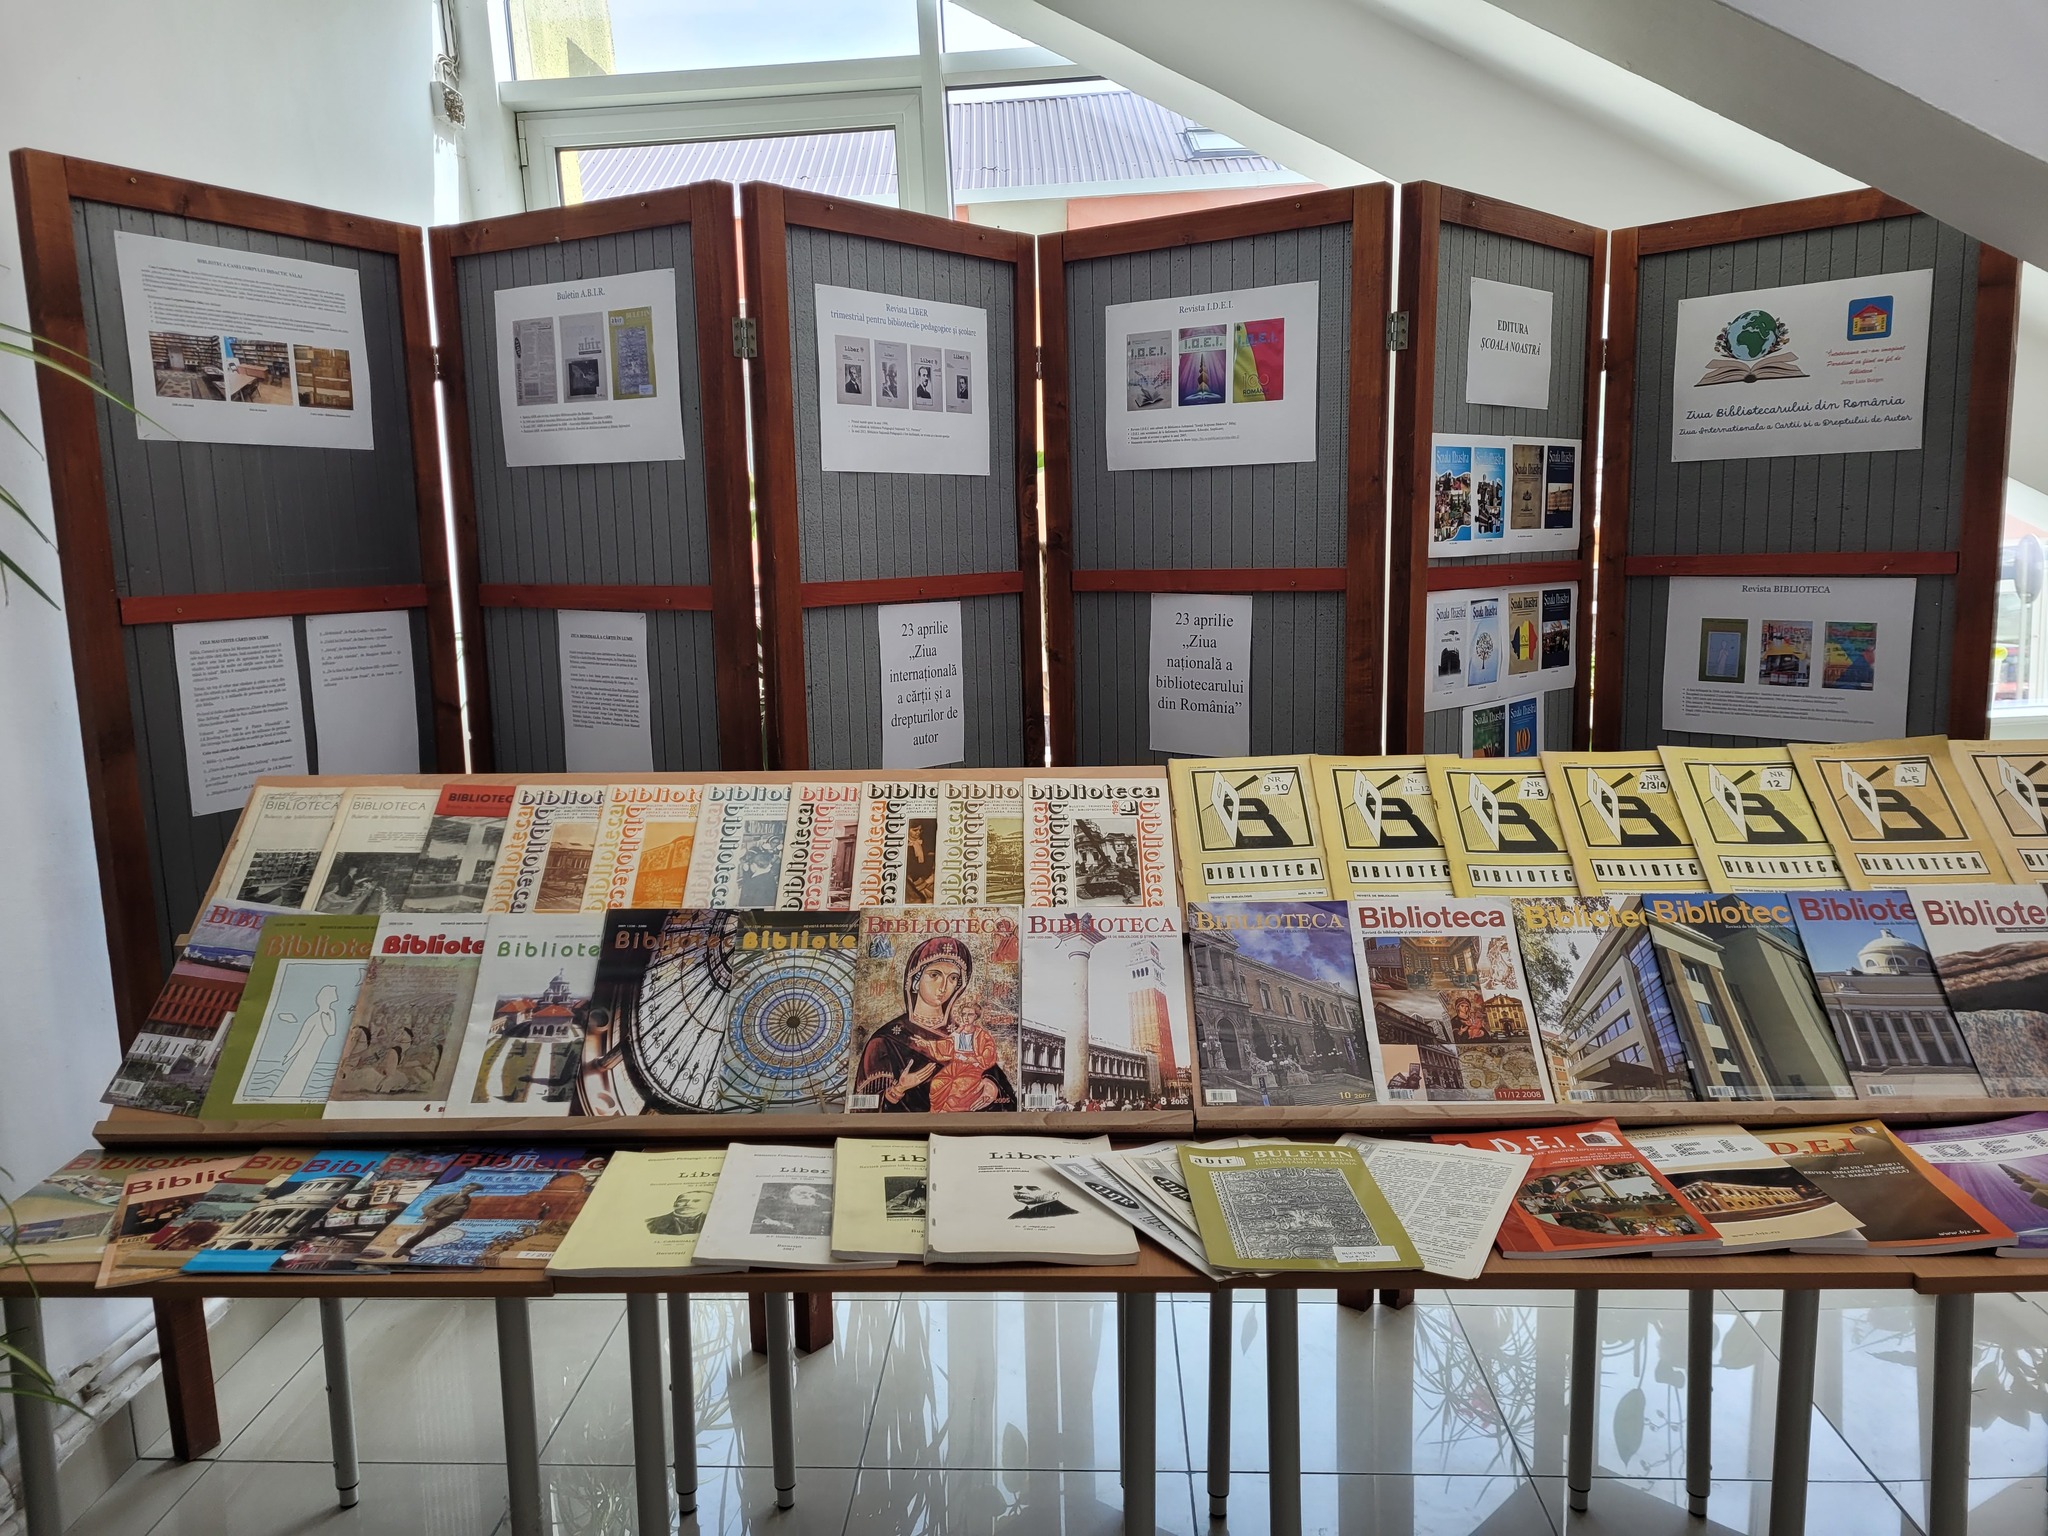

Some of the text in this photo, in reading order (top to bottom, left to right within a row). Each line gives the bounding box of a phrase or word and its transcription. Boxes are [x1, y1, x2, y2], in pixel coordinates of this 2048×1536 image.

[556, 288, 606, 300] Buletin A.B.I.R.
[886, 304, 928, 318] Revista LIBER
[1179, 301, 1234, 314] Revista I.D.E.I.
[830, 310, 976, 337] trimestrial pentru bibliotecile pedagogice și școlare
[1497, 320, 1529, 335] EDITURA
[1184, 336, 1223, 349] I.D.E.I.
[1480, 337, 1541, 356] ȘCOALA NOASTRĂ
[1686, 396, 1905, 420] Ziua Bibliotecarului din România
[1679, 427, 1697, 436] Ziua
[1822, 416, 1869, 428] Dreptului
[1871, 415, 1882, 423] de
[1884, 414, 1912, 422] Autor
[1742, 584, 1831, 594] Revista BIBLIOTECA
[1176, 612, 1234, 629] 23 aprilie
[902, 621, 948, 639] 23 aprilie
[1182, 635, 1217, 649] „Ziua
[909, 645, 937, 661] „Ziua
[1167, 656, 1233, 671] națională a
[890, 663, 957, 683] internațională
[1156, 675, 1244, 693] bibliotecarului
[897, 686, 951, 705] a cărții și a
[1158, 697, 1242, 714] din România”
[891, 706, 958, 729] drepturilor de
[913, 732, 938, 746] autor
[1903, 766, 1919, 774] NR
[1267, 776, 1284, 784] NR.
[1639, 781, 1666, 791] 2/3/4
[1766, 780, 1782, 789] 12
[800, 786, 861, 801] bibli
[1028, 784, 1160, 800] biblioteca
[1263, 783, 1288, 793] 9-10
[266, 801, 339, 810] BIBLIOTECA
[352, 802, 426, 810] BIBLIOTECA
[509, 806, 556, 914] biblioteca
[1861, 857, 1982, 870] BIBLIOTECA
[1206, 862, 1318, 879] BIBLIOTECA
[1596, 864, 1698, 877] BIBLIOTEC
[1358, 906, 1506, 929] Biblioteca
[1653, 900, 1791, 924] Bibliotec
[866, 916, 1012, 934] BIBLIOTECA
[1028, 916, 1176, 934] BIBLIOTECA
[1196, 912, 1345, 930] BIBLIOTECA
[1160, 1096, 1166, 1106] 8
[1339, 1091, 1351, 1100] 10
[1523, 1090, 1542, 1098] 2008
[989, 1152, 1062, 1160] Liber
[1252, 1150, 1353, 1158] BULETIN
[1938, 1228, 1980, 1237] www.bjs.ro
